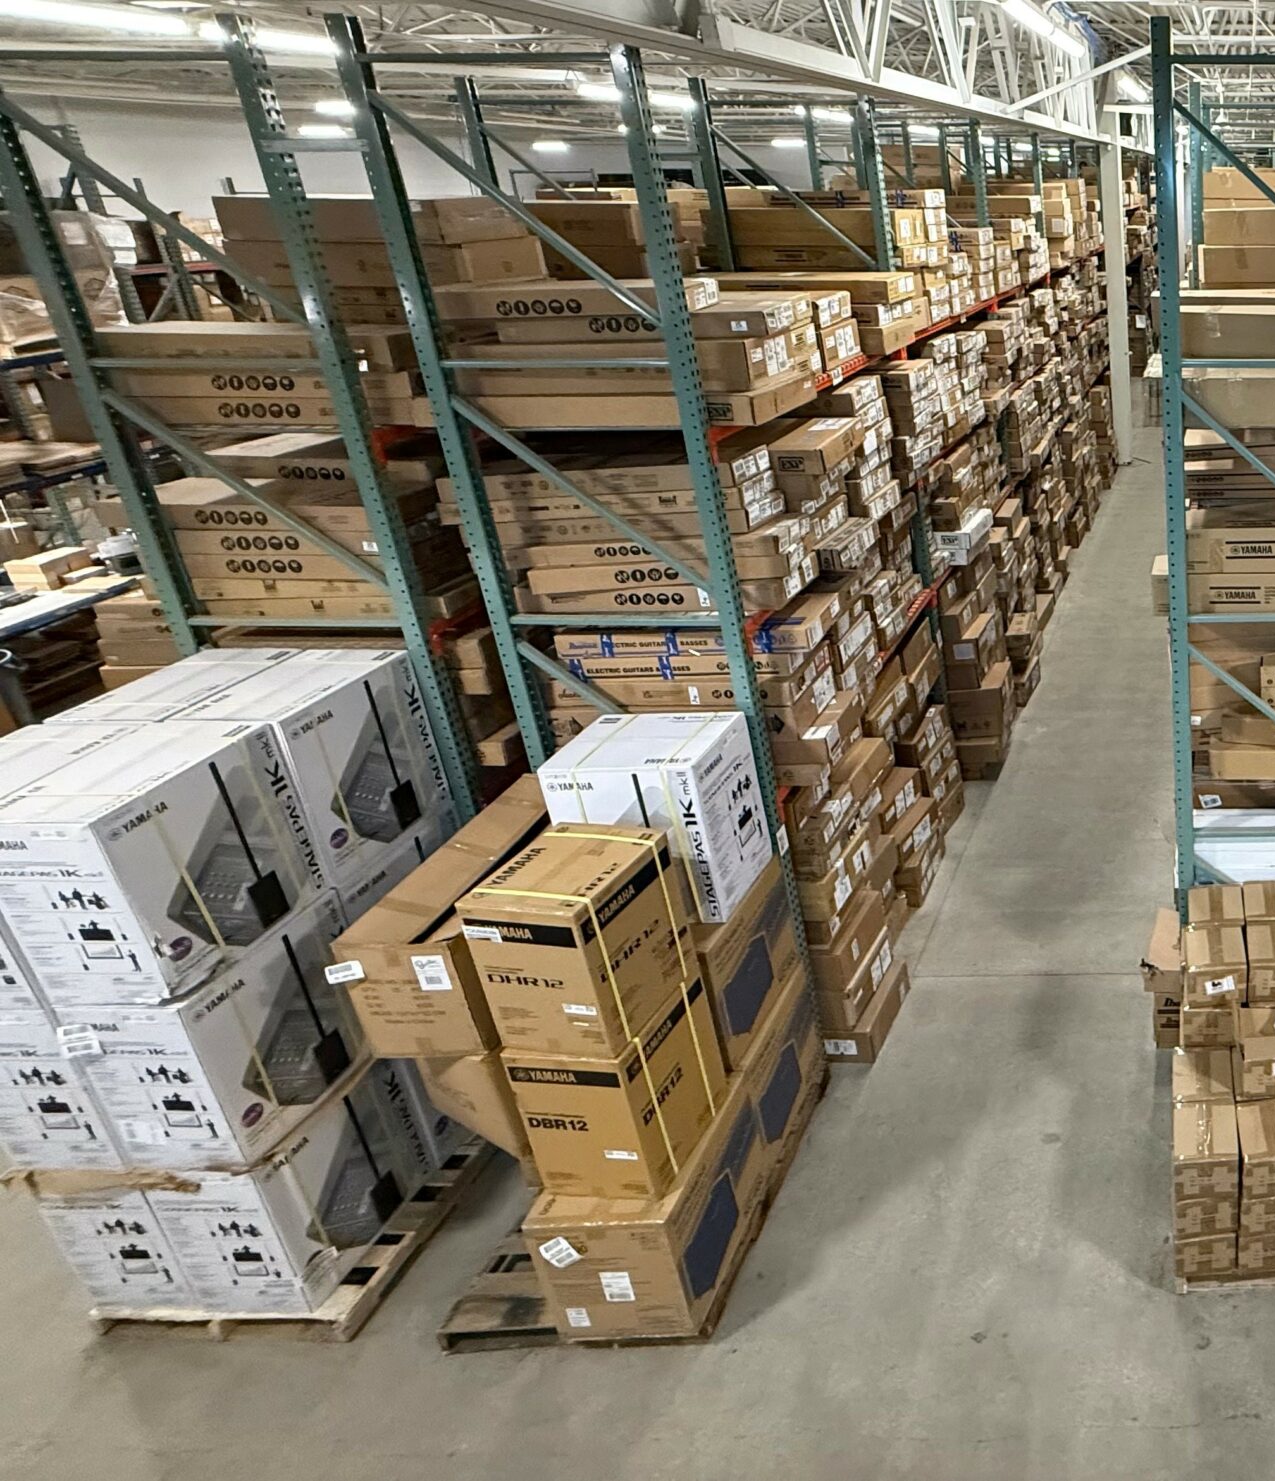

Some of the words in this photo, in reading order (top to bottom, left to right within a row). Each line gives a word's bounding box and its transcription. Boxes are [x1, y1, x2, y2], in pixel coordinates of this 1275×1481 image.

[1240, 545, 1273, 554] YAMAHA
[1224, 590, 1256, 600] YAMAHA
[264, 759, 290, 798] 1K
[557, 781, 594, 792] YAMAHA
[678, 798, 698, 829] 1K
[487, 847, 547, 888] YAMAHA
[692, 830, 721, 919] STAGEPAS
[598, 884, 636, 923] YAMAHA
[487, 973, 566, 990] DHR12
[528, 1070, 577, 1083] YAMAHA
[527, 1116, 589, 1132] DBR12
